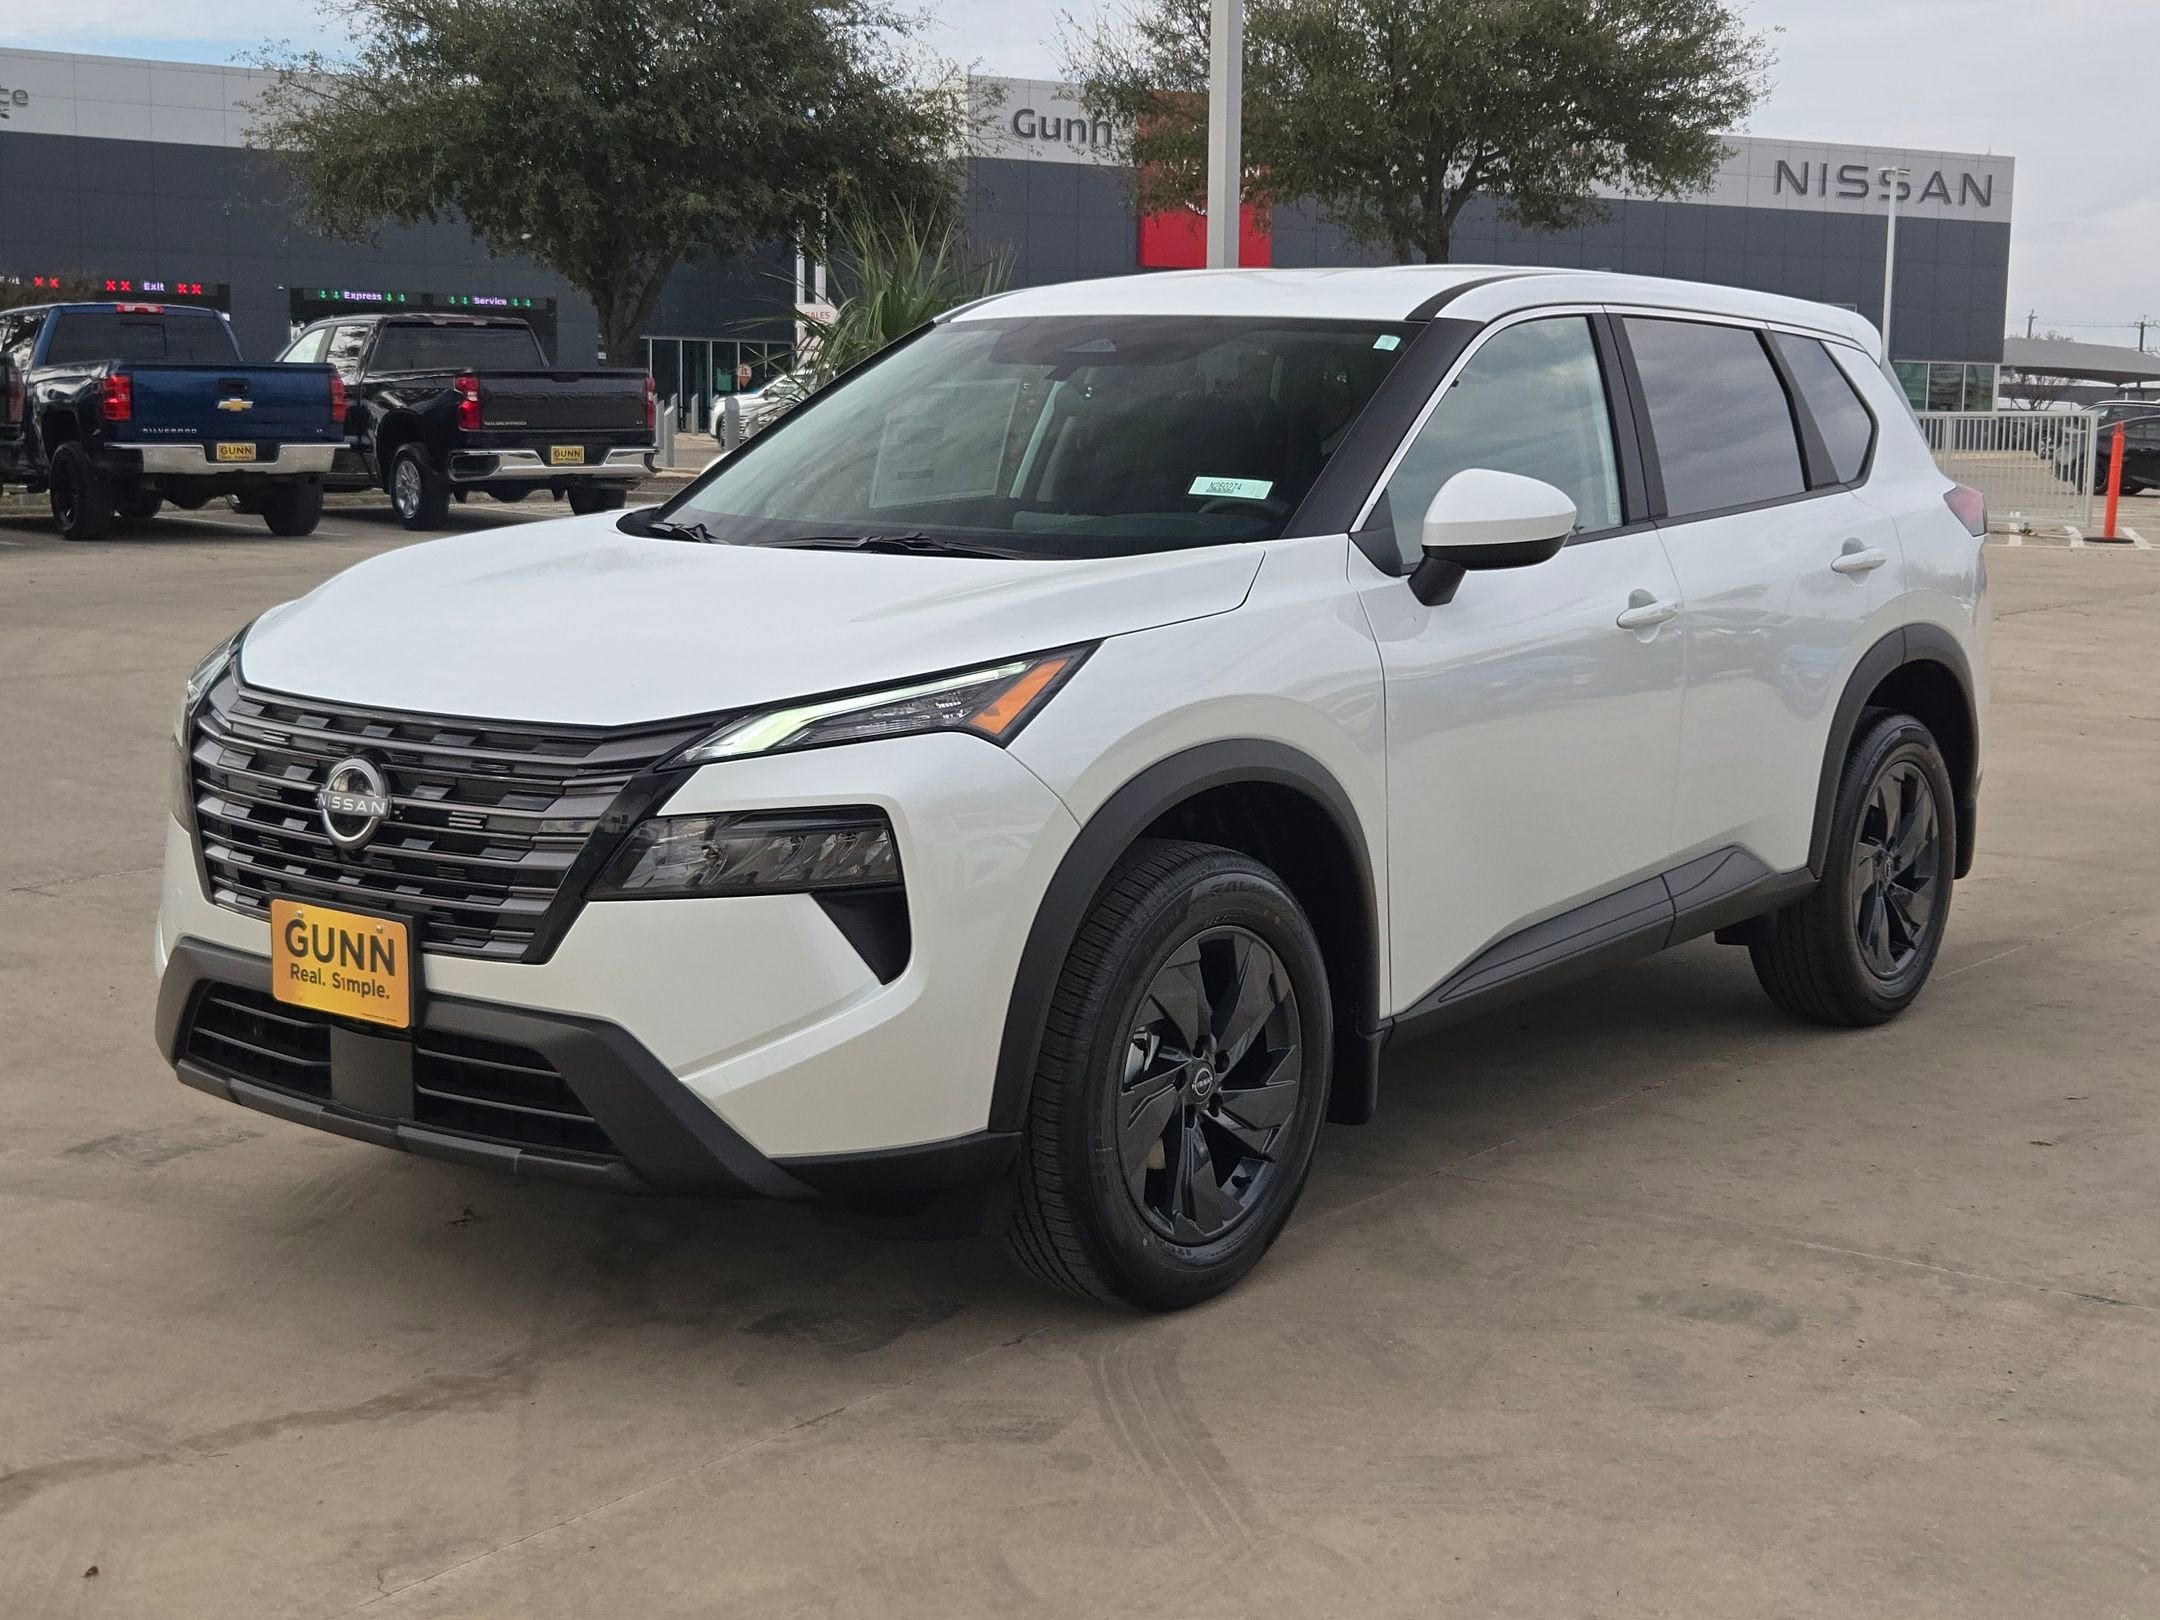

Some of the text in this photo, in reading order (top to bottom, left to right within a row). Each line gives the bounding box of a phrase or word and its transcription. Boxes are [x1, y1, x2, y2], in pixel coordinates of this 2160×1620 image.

[1012, 108, 1114, 144] Gunn
[1774, 160, 1992, 207] NISSAN
[143, 281, 165, 292] Exit
[343, 290, 382, 301] Express
[474, 296, 507, 306] Service
[804, 311, 831, 320] SALES
[220, 446, 253, 455] GUNN
[554, 449, 581, 458] GUNN
[317, 792, 385, 814] NISSAN
[284, 918, 396, 977] GUNN
[290, 962, 390, 1000] Real. Simple.
